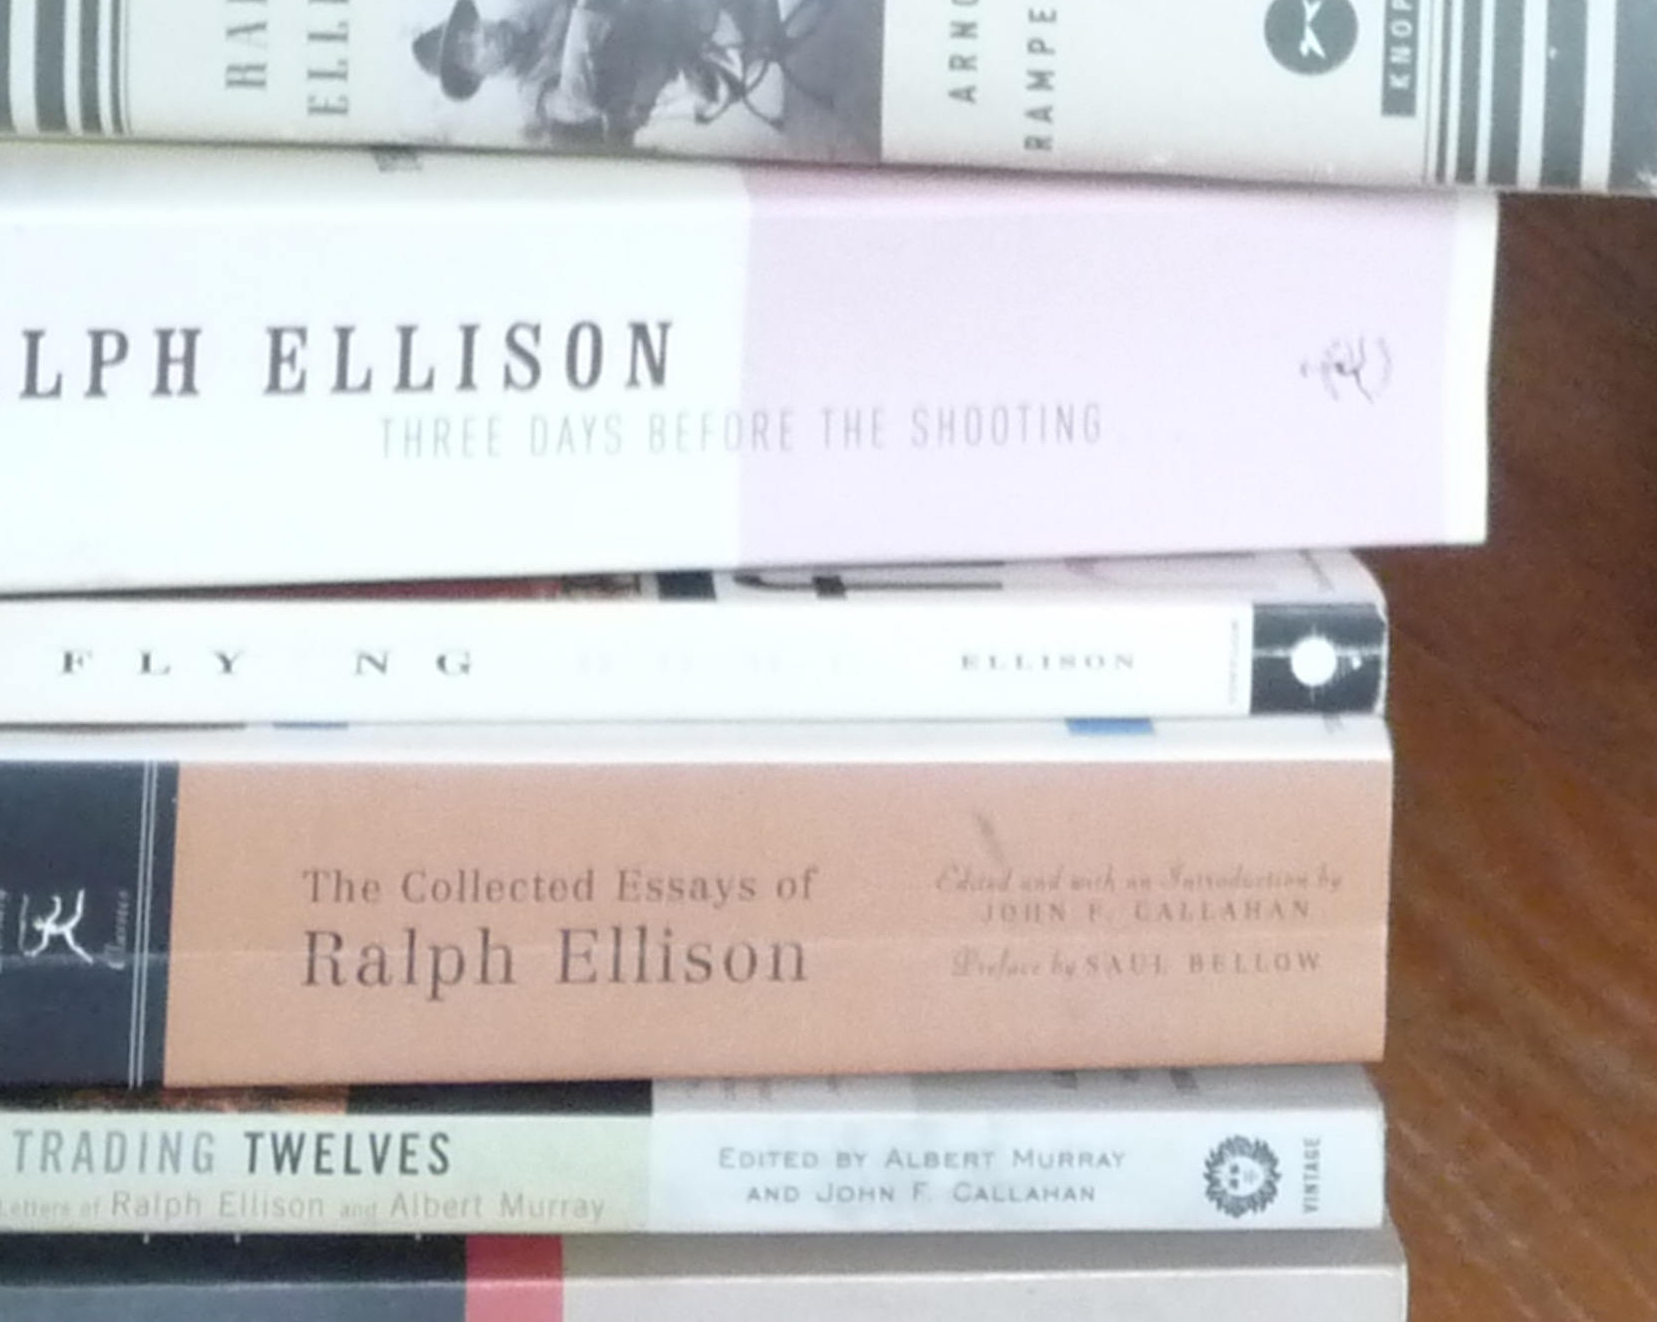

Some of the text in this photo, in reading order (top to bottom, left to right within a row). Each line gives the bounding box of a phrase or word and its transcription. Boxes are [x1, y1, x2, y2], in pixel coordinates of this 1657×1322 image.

[263, 320, 674, 397] ELLISON
[381, 402, 1103, 459] THREE DAYS BEFORE THE SHOOTING
[960, 652, 1139, 672] ELLISON
[303, 864, 819, 909] The Collected Essays of
[981, 902, 1066, 923] JOHN
[1134, 899, 1310, 922] CALLAHAN
[301, 924, 808, 1002] Ralph Ellison
[1087, 954, 1169, 976] SAUL
[1190, 951, 1321, 974] BELLOW
[13, 1129, 452, 1175] TRADING TWELVES
[1302, 1137, 1321, 1213] VINTAGE
[112, 1190, 202, 1220] Ralph
[219, 1189, 325, 1219] Ellison
[341, 1197, 378, 1219] and
[390, 1190, 484, 1220] Albert
[499, 1192, 606, 1224] Murray
